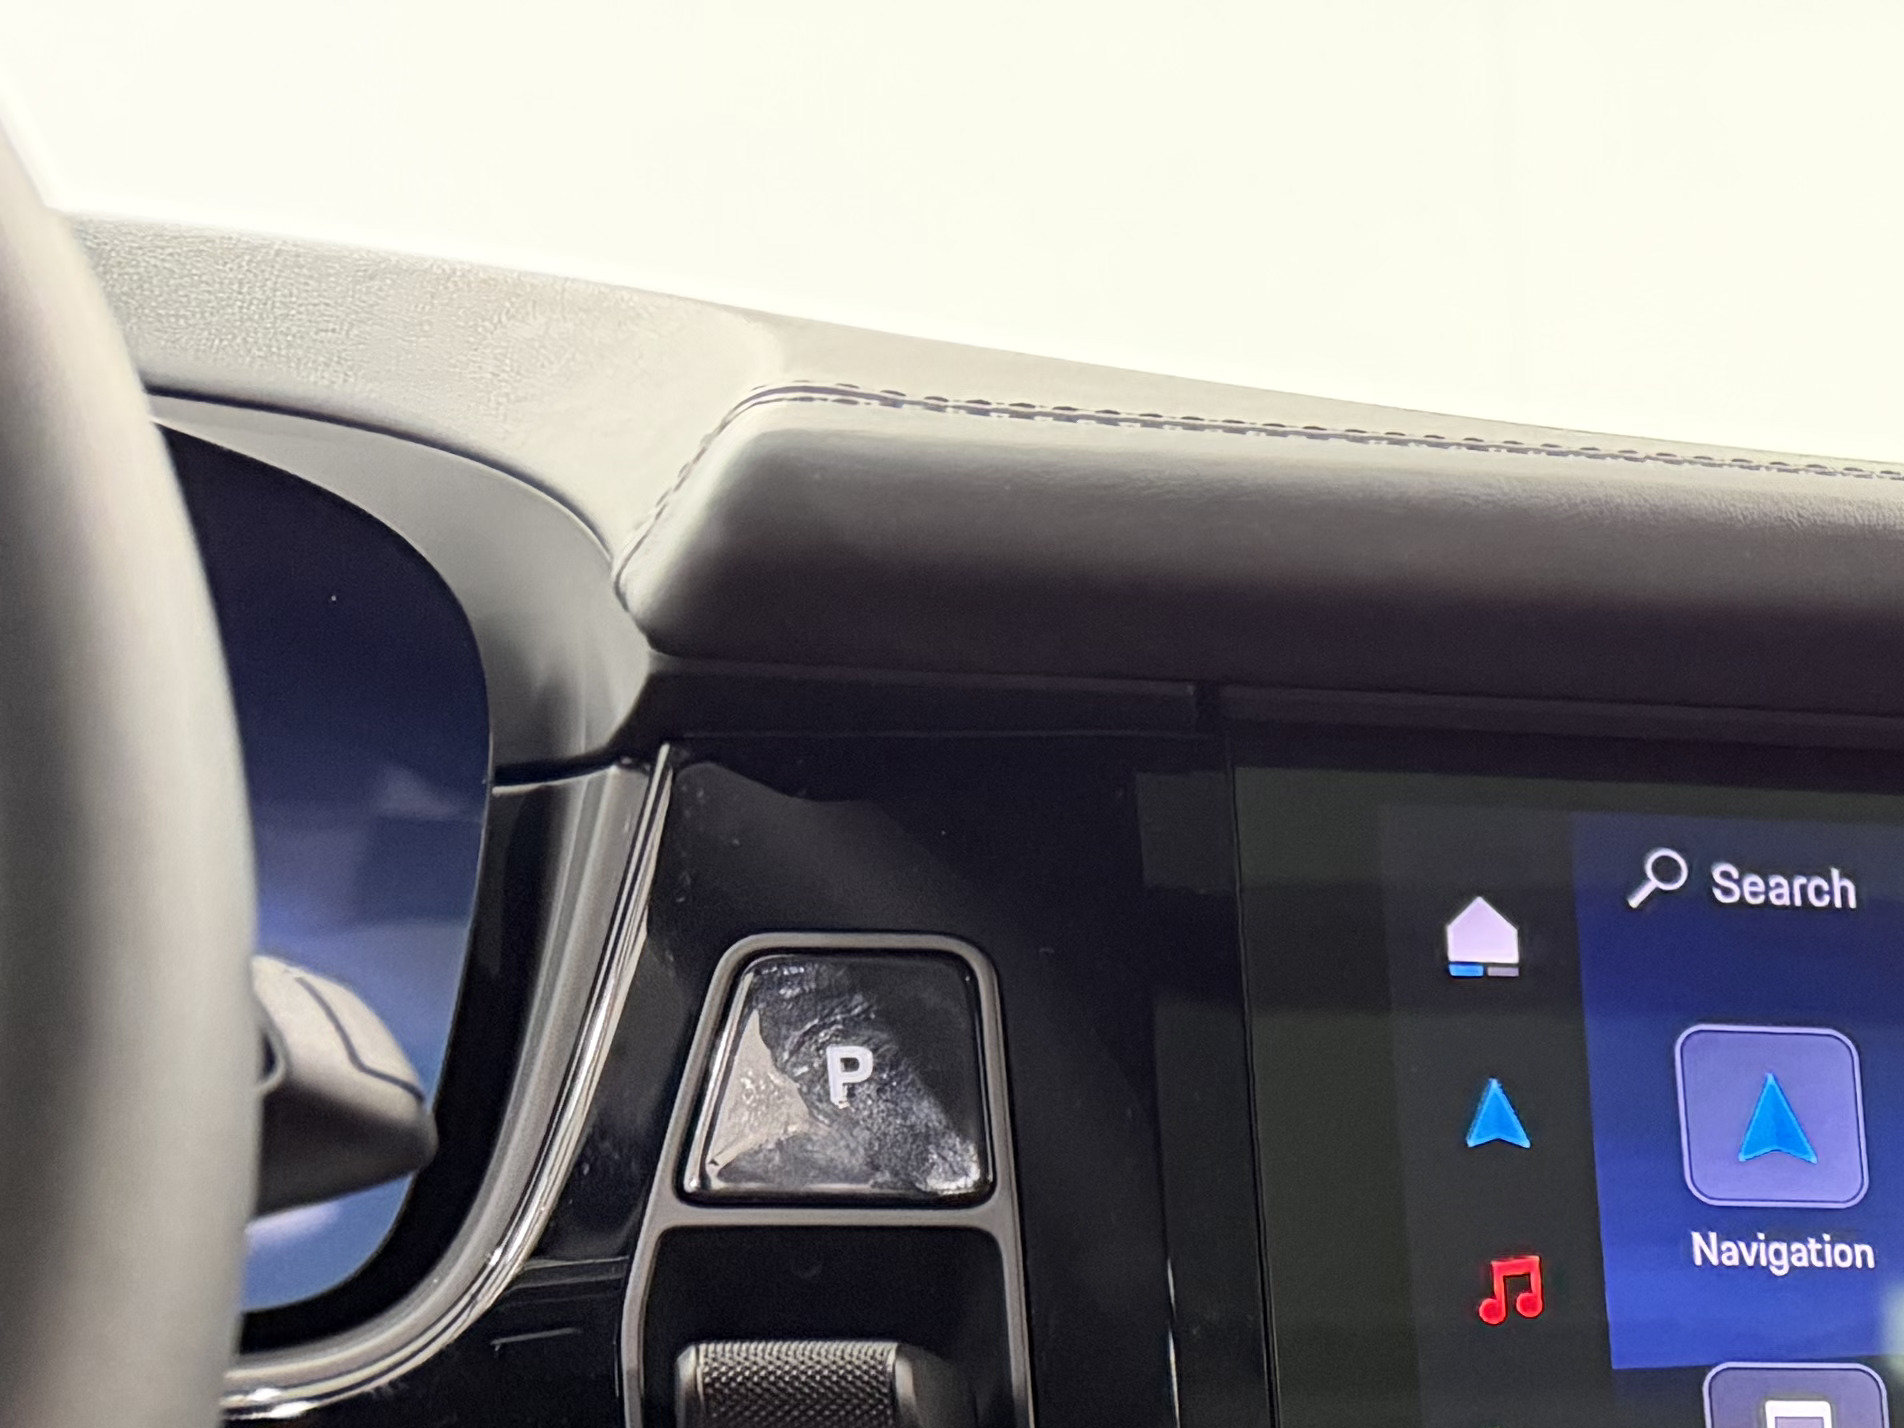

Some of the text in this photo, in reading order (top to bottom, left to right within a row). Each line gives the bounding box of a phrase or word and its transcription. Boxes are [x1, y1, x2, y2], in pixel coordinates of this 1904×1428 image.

[1713, 864, 1856, 908] Search
[826, 1046, 873, 1109] P
[1692, 1232, 1875, 1276] Navigation
